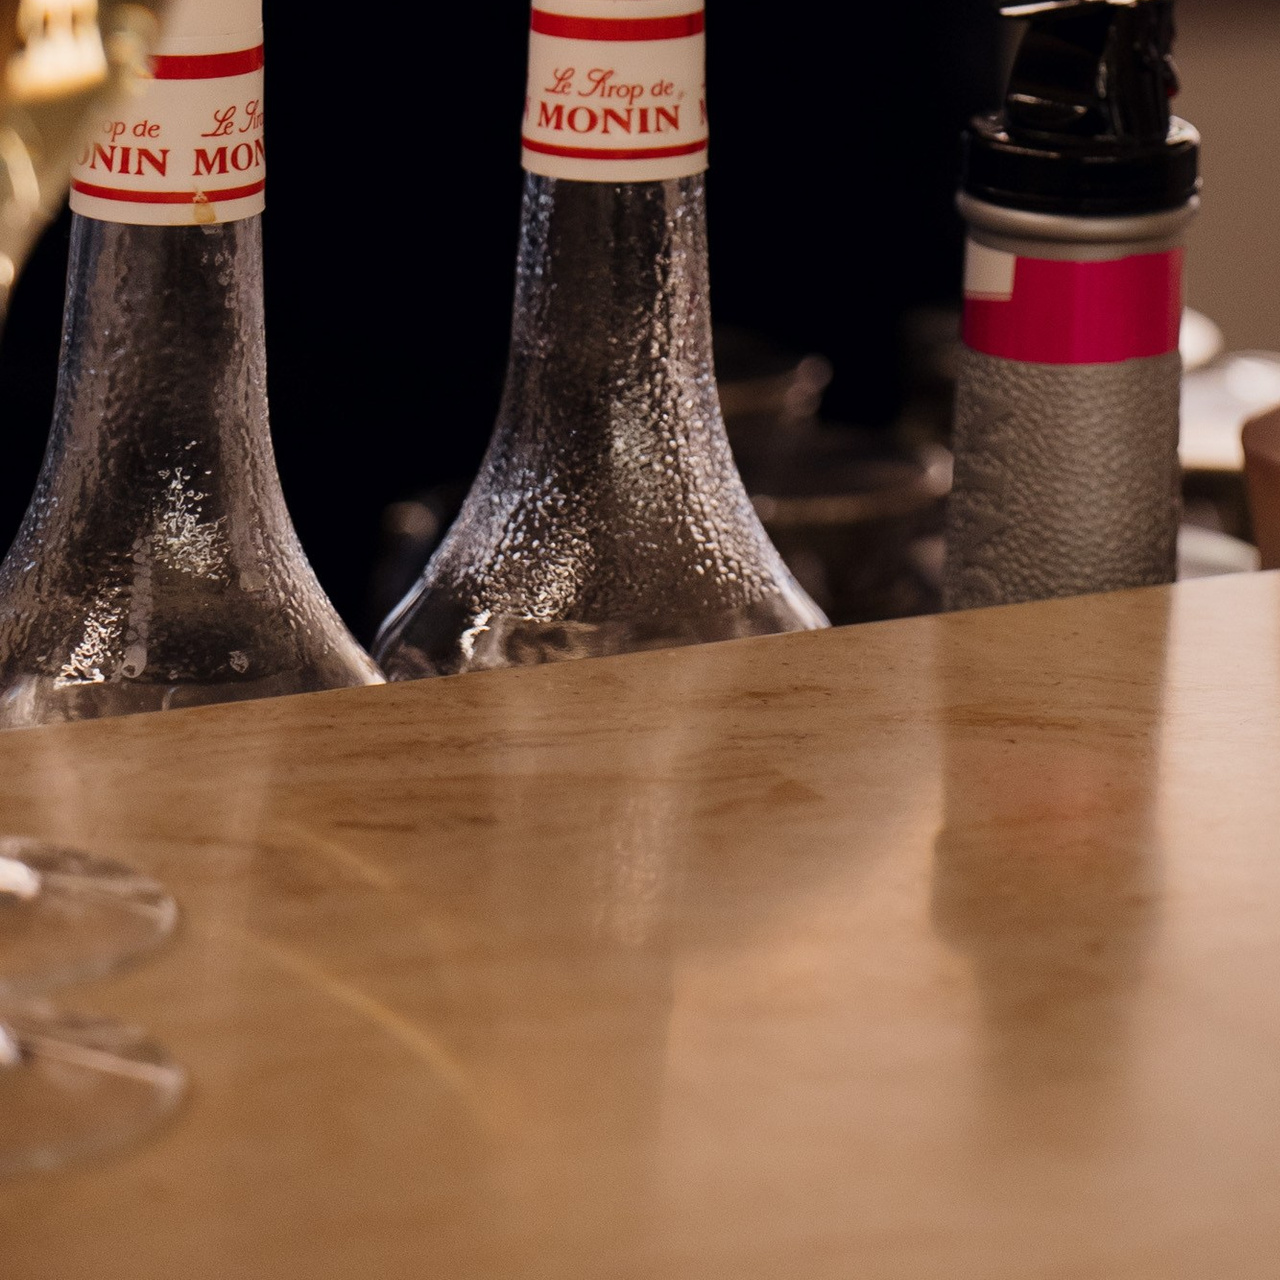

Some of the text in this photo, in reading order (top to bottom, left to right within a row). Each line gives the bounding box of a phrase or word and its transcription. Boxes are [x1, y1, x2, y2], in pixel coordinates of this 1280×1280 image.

[651, 80, 674, 97] de
[538, 101, 681, 134] MONIN
[133, 120, 160, 138] de
